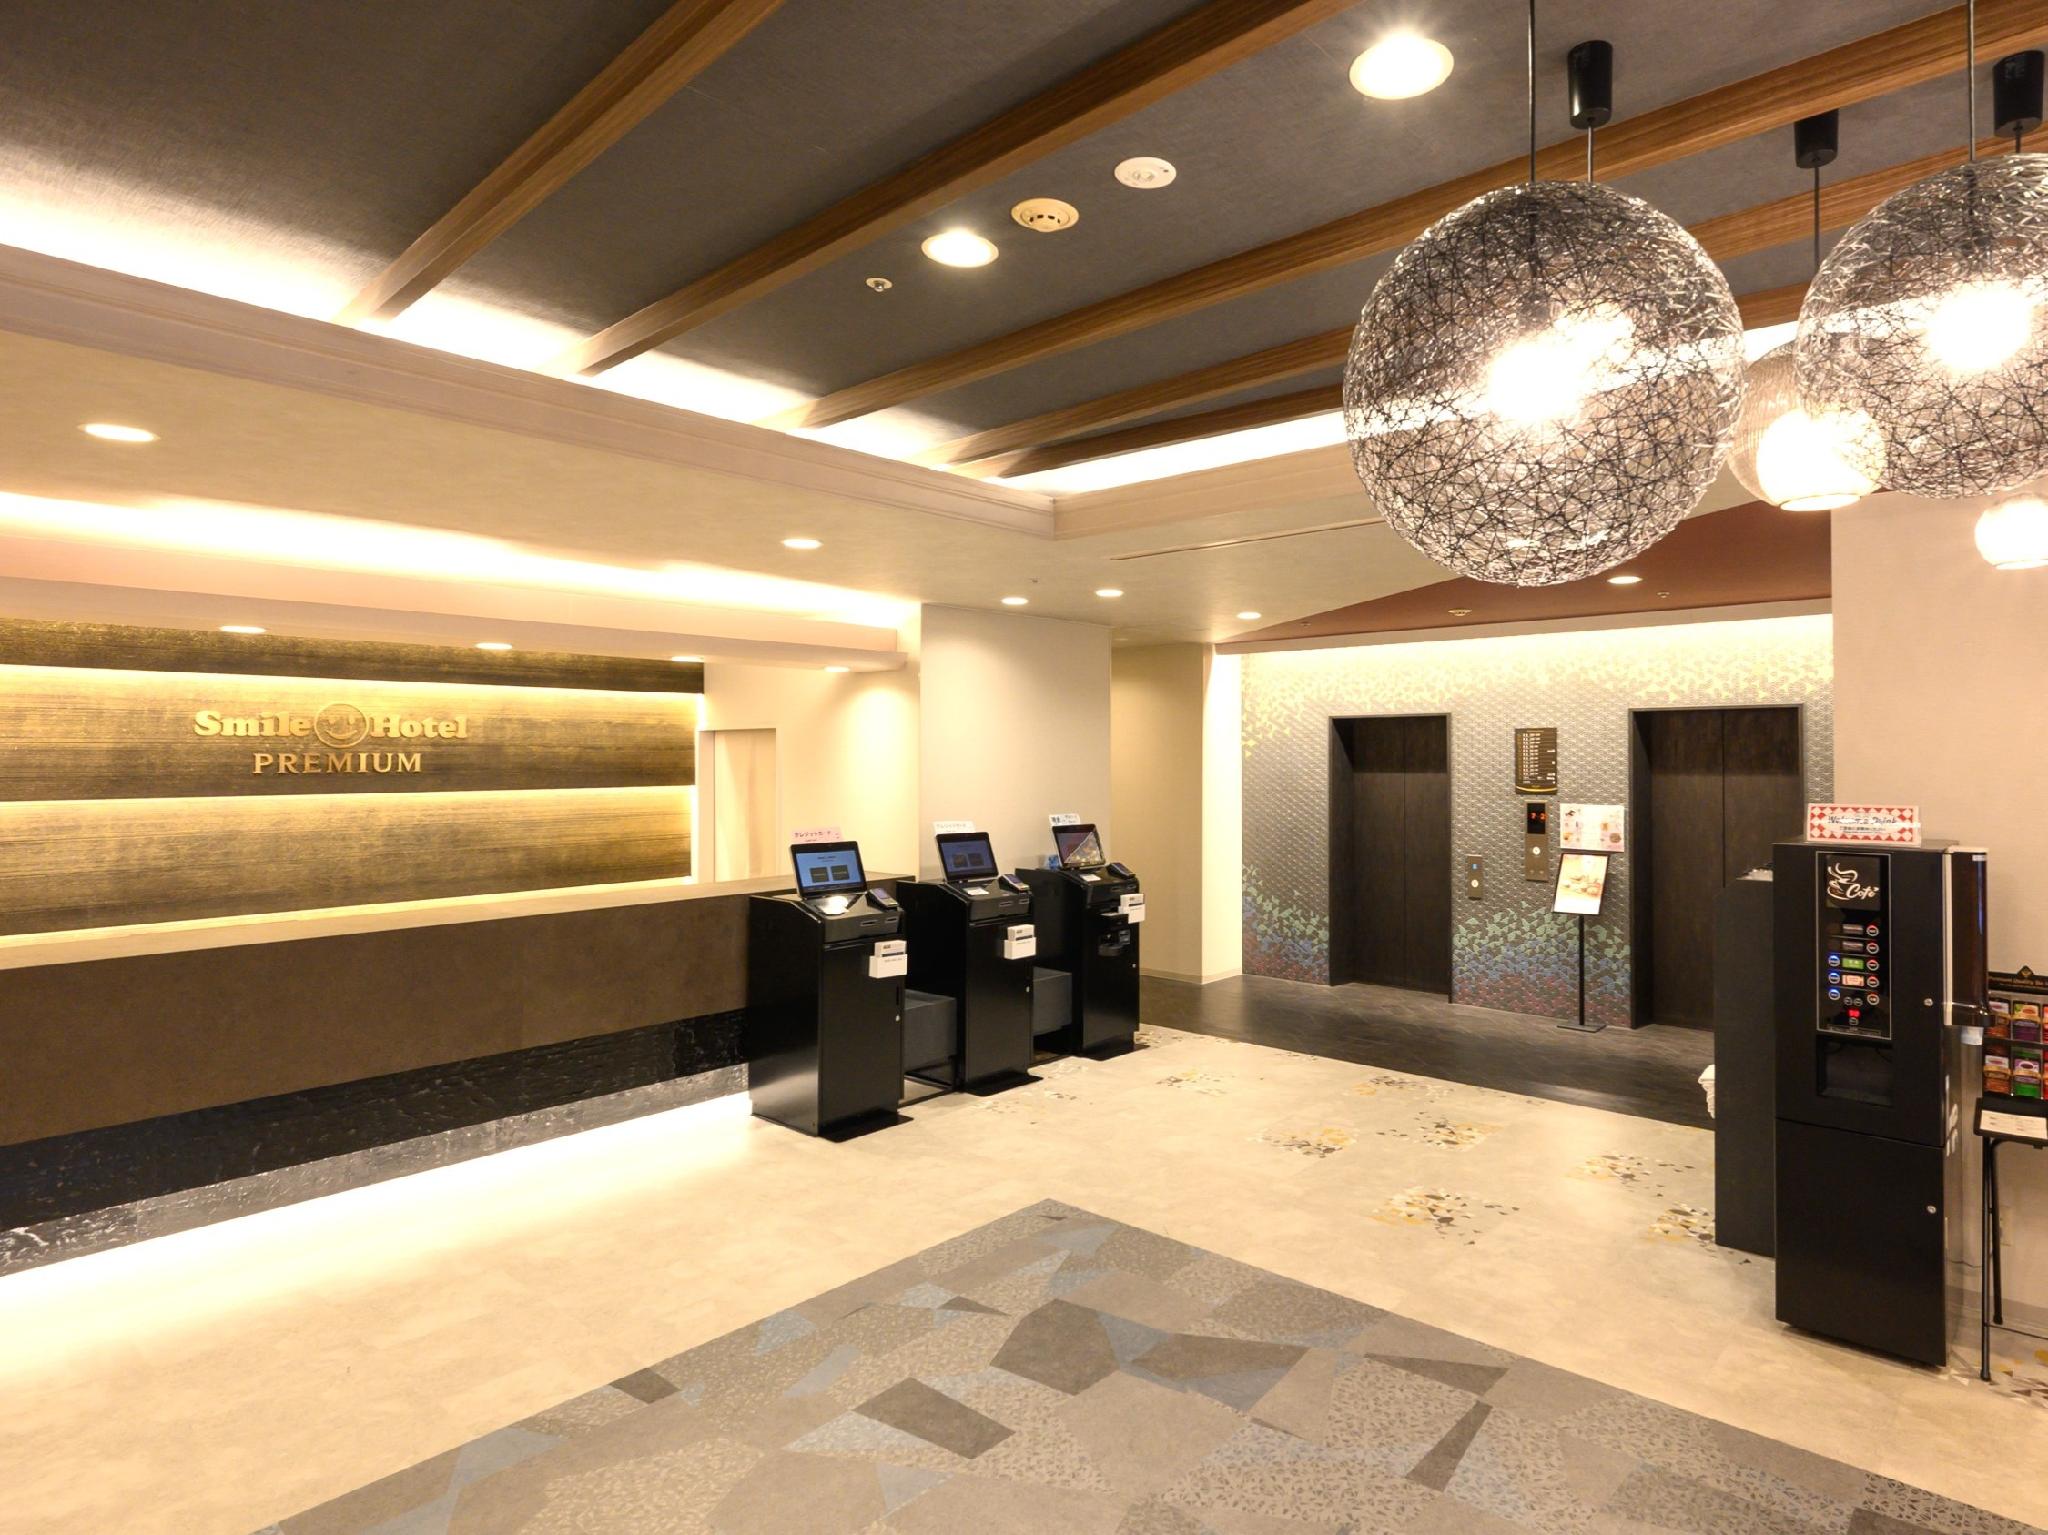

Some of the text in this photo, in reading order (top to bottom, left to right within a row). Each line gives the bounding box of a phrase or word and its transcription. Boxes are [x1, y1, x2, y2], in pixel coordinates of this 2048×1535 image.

[194, 709, 468, 739] Smile Hotel
[252, 751, 422, 775] PREMIUM
